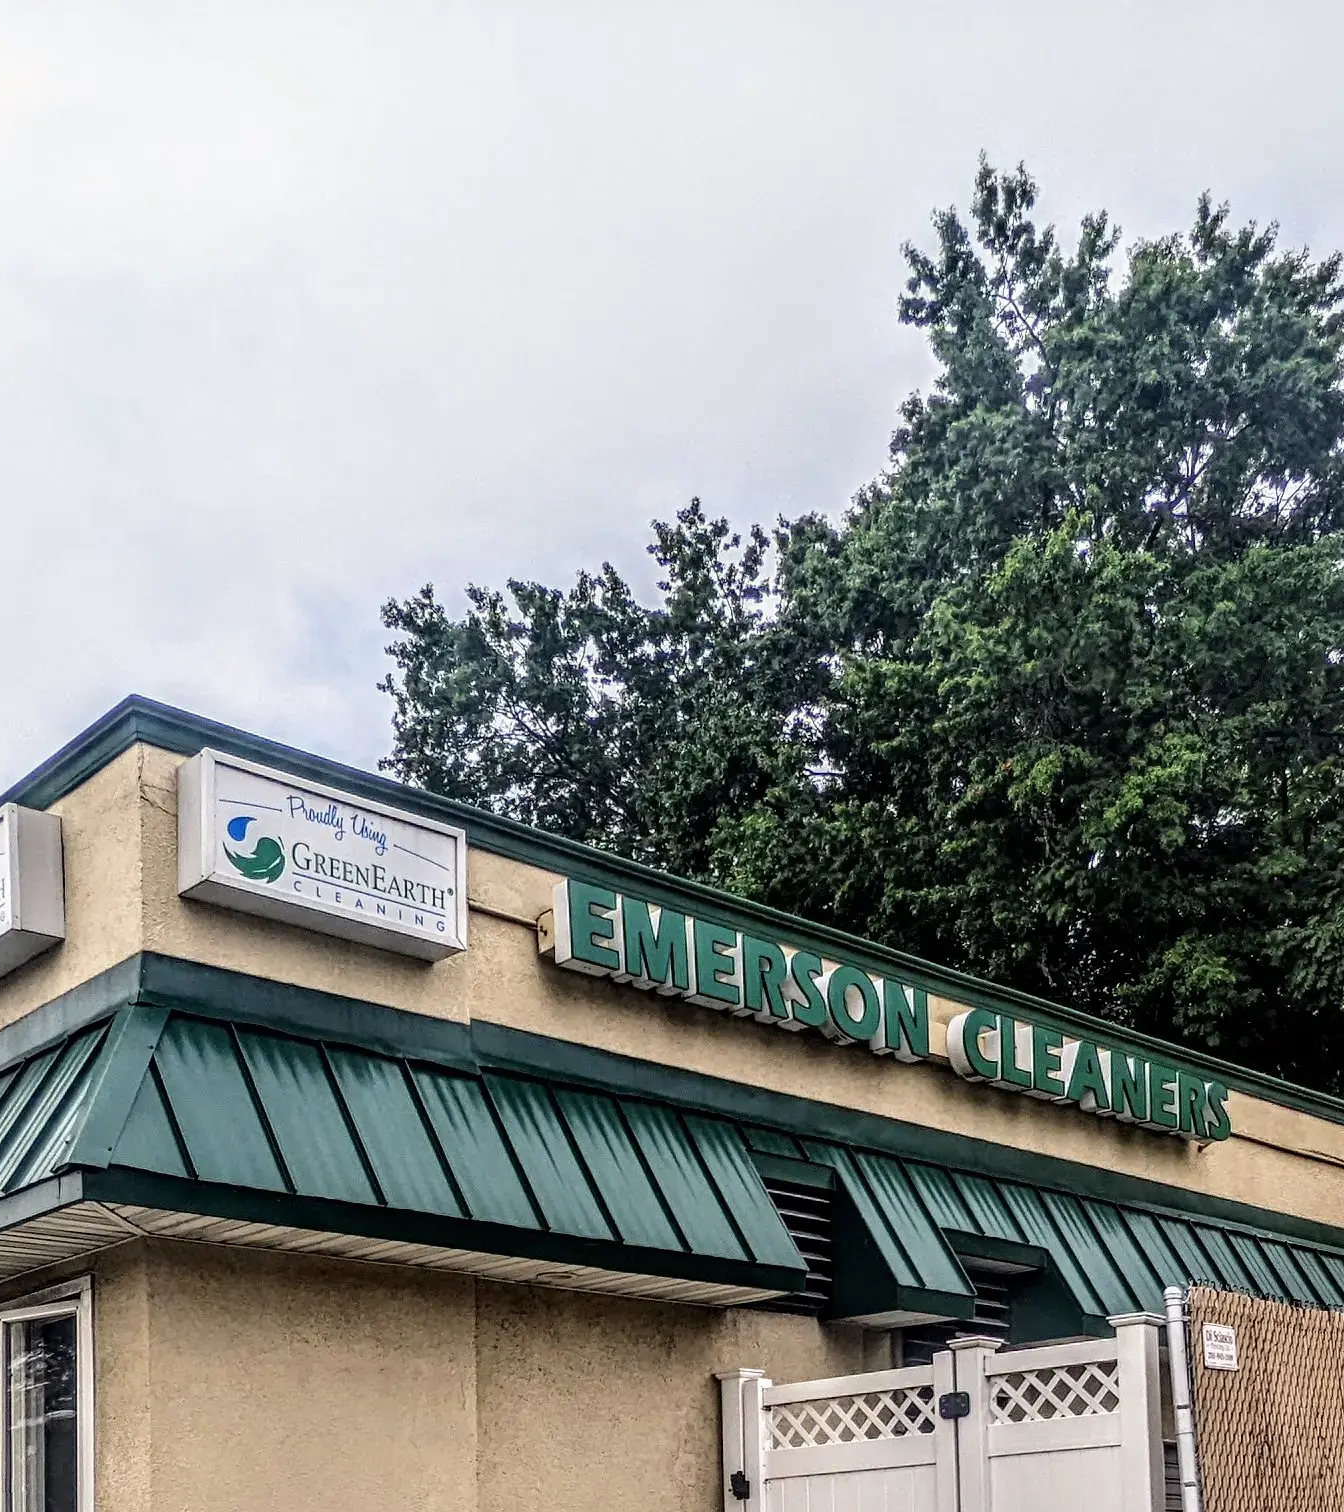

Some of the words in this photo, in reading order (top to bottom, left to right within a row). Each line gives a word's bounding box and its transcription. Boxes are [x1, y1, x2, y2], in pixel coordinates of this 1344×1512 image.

[286, 795, 346, 841] Proudly
[351, 813, 389, 857] Using
[293, 880, 446, 932] CLEANING
[564, 878, 930, 1060] EMERSON
[956, 1007, 1231, 1143] CLEANERS
